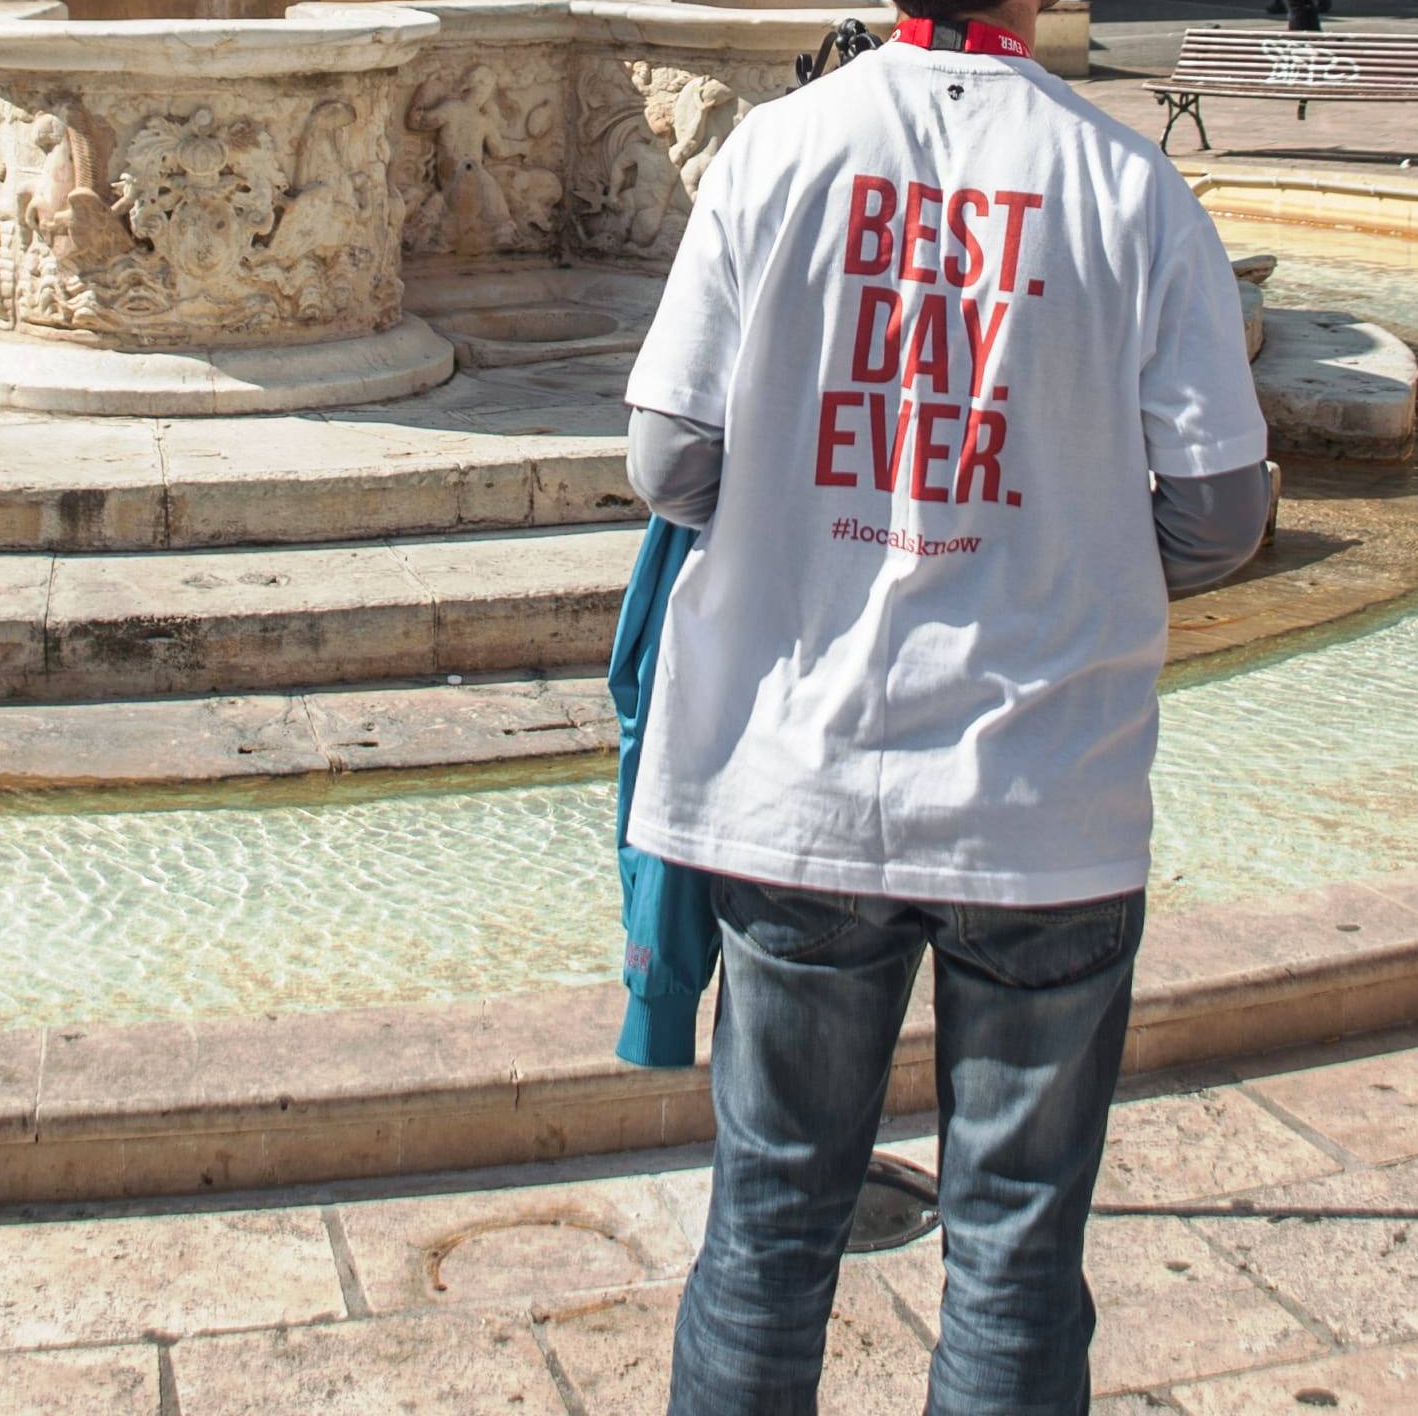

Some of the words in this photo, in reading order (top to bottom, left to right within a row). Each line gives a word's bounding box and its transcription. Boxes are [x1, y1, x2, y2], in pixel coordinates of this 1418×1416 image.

[843, 174, 1046, 297] BEST.
[851, 285, 1010, 401] DAY.
[814, 390, 1023, 508] EVER.
[831, 517, 982, 557] #localsknow
